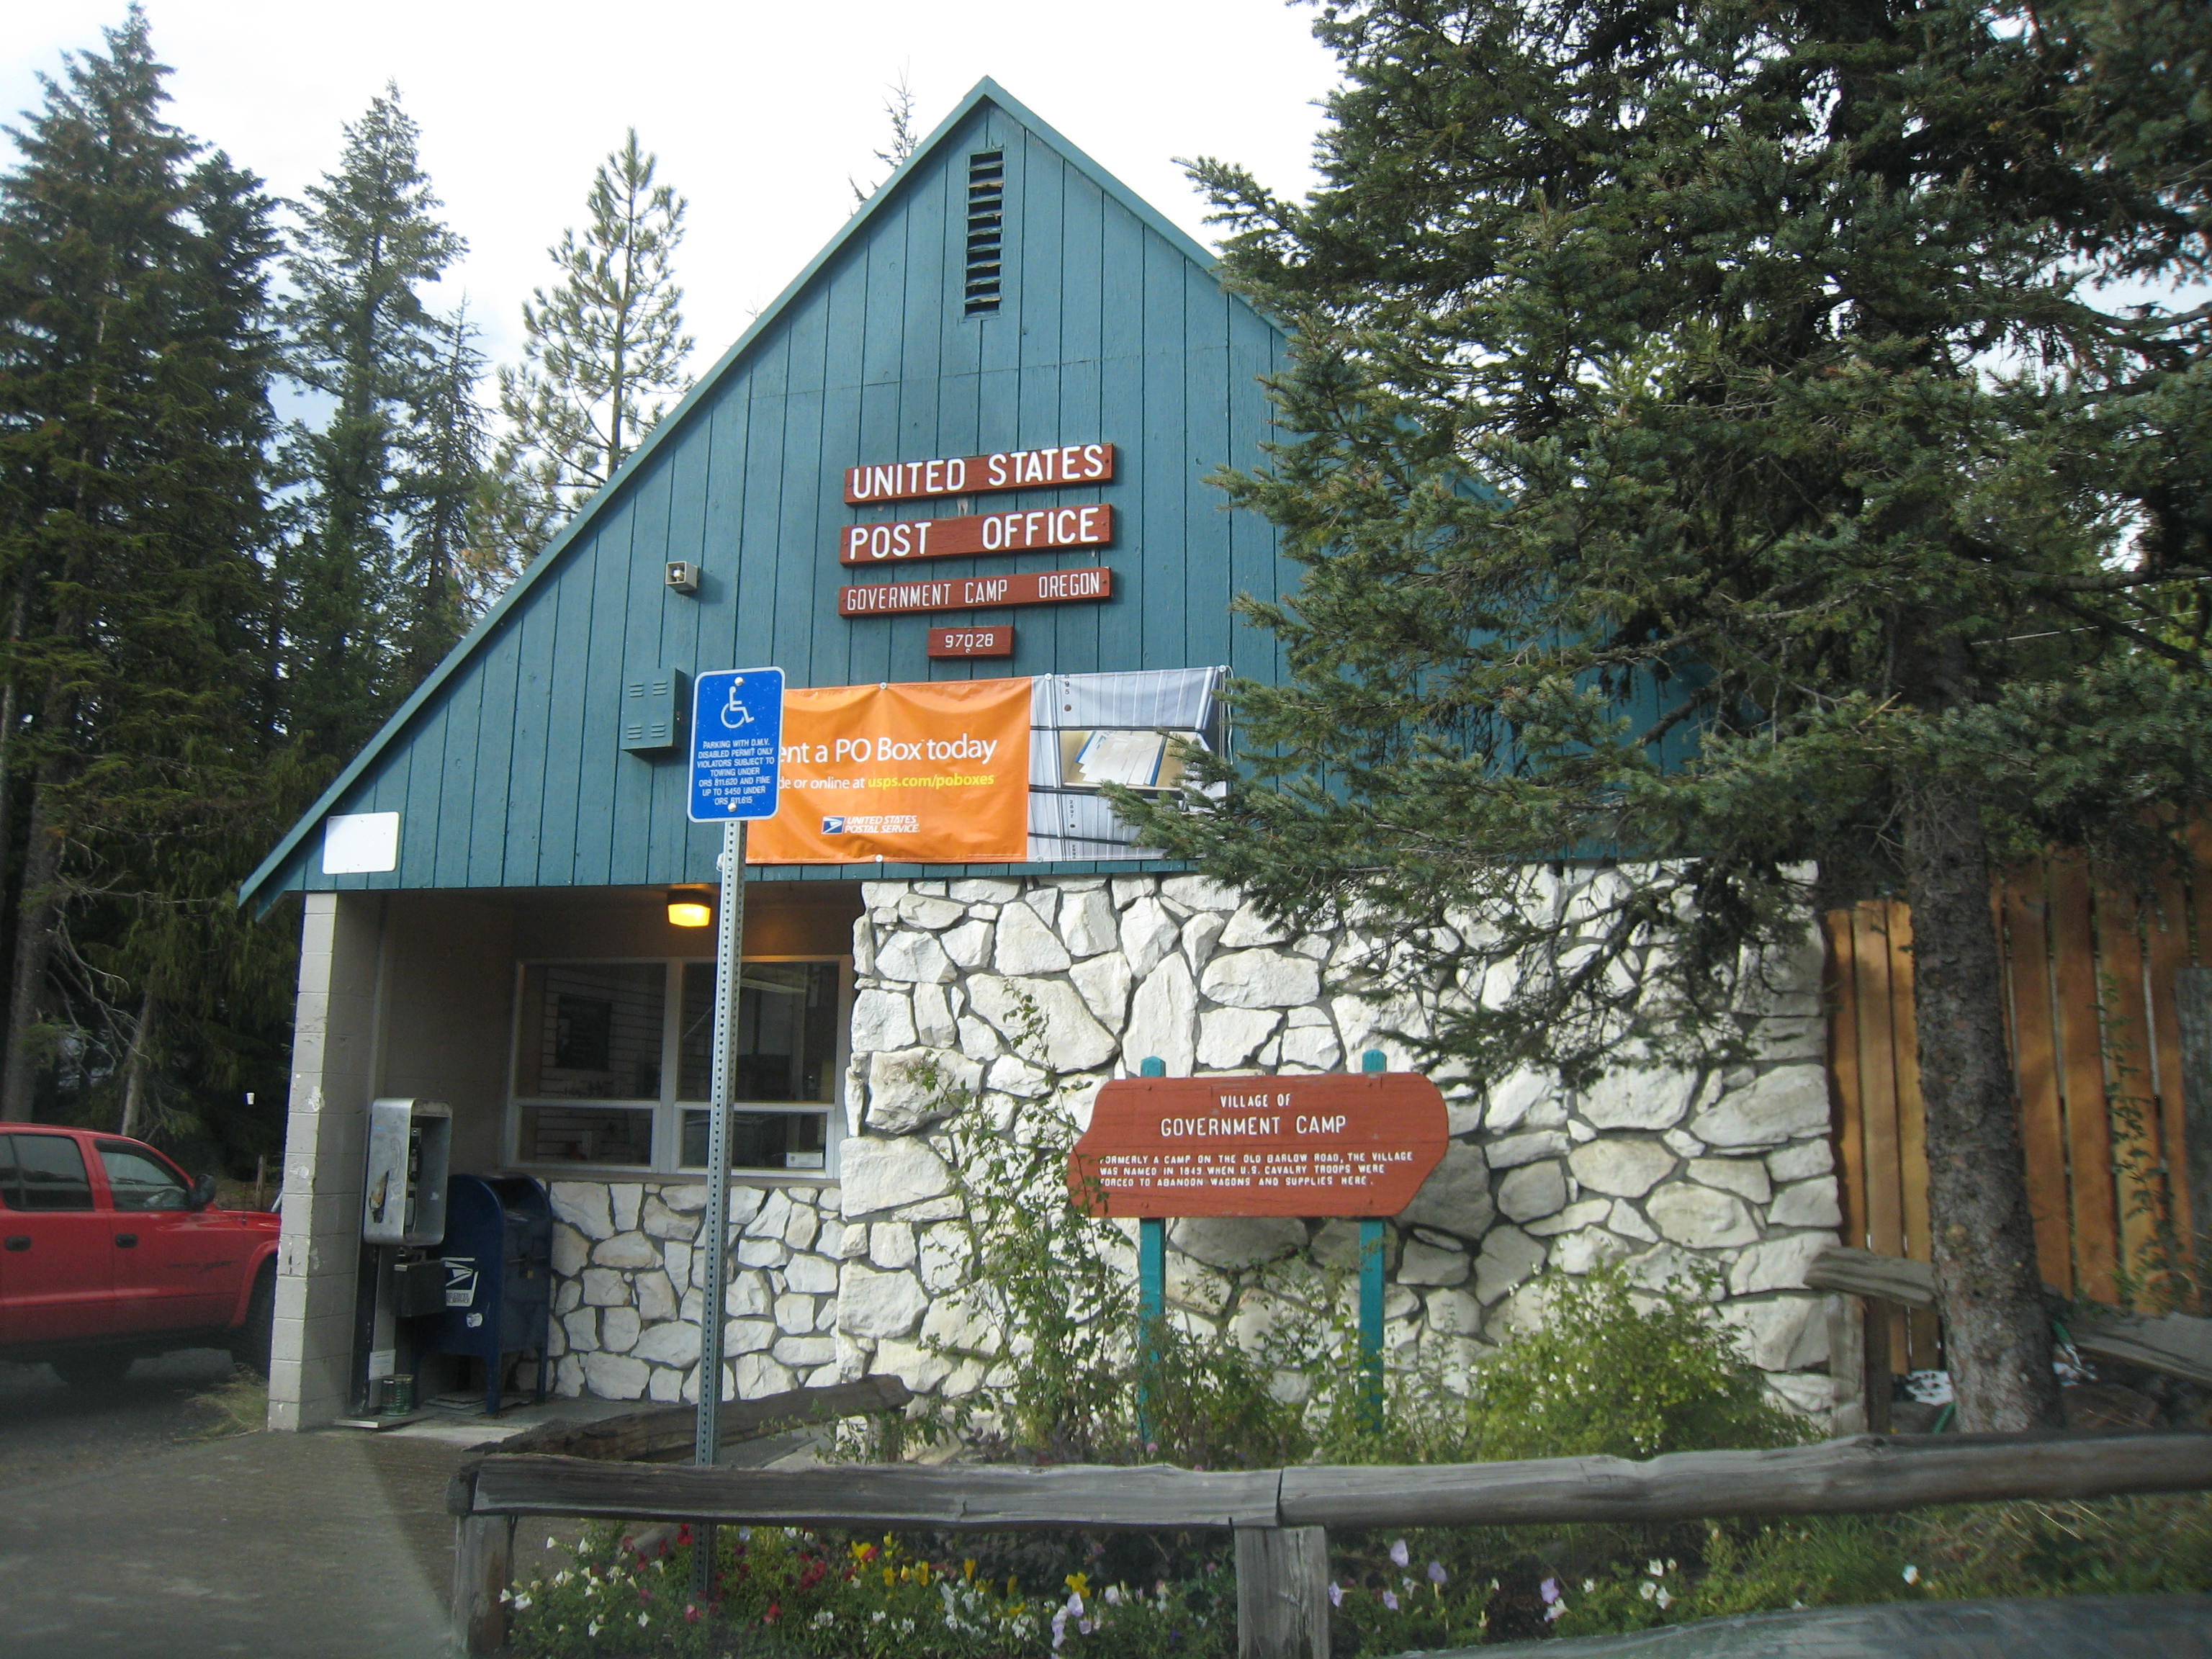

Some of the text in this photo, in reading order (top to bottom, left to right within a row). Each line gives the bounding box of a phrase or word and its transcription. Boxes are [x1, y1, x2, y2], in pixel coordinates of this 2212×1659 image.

[853, 444, 1104, 499] UNITED STATES
[850, 507, 1100, 560] POST OFFICE
[847, 572, 1100, 611] GOVERNMENT CAMP OREGON
[945, 633, 994, 649] 97028
[703, 740, 731, 749] PARKING
[781, 733, 998, 765] ent a PO Box today
[698, 750, 729, 759] DISABLED
[732, 747, 755, 757] PERMIT
[697, 759, 732, 768] VIOLATORS
[734, 757, 763, 766] SUBJECT
[710, 767, 760, 777] TOWING UNDER
[793, 779, 808, 788] or
[810, 776, 850, 789] online
[853, 778, 866, 788] at
[868, 773, 995, 790] usps.com/poboxes
[743, 786, 766, 794] UNDER
[847, 815, 917, 824] UNITED STATES
[1220, 1093, 1291, 1108] VILLAGE OF
[1161, 1115, 1346, 1137] GOVERNMENT CAMP
[1154, 1155, 1159, 1164] A
[1164, 1155, 1191, 1164] CAMP
[1197, 1155, 1211, 1164] ON
[1218, 1154, 1236, 1164] THE
[1244, 1154, 1261, 1164] OLD
[1267, 1154, 1308, 1164] BARLOW
[1314, 1153, 1344, 1164] ROAD,
[1347, 1152, 1365, 1161] THE
[1372, 1152, 1413, 1161] VILLAGE
[1100, 1167, 1118, 1176] WAS
[1123, 1167, 1157, 1176] NAMED
[1179, 1166, 1202, 1175] 1849
[1207, 1166, 1235, 1175] WHEN
[1241, 1166, 1260, 1174] U.S.
[1264, 1165, 1307, 1174] CAVALRY
[1314, 1164, 1351, 1174] TROOPS
[1358, 1164, 1385, 1174] WERE
[1100, 1178, 1134, 1187] FORCED
[1140, 1178, 1150, 1187] TO
[1157, 1178, 1204, 1187] ABANDON
[1210, 1177, 1251, 1187] WAGONS
[1258, 1177, 1279, 1186] AND
[1285, 1176, 1333, 1186] SUPPLIES
